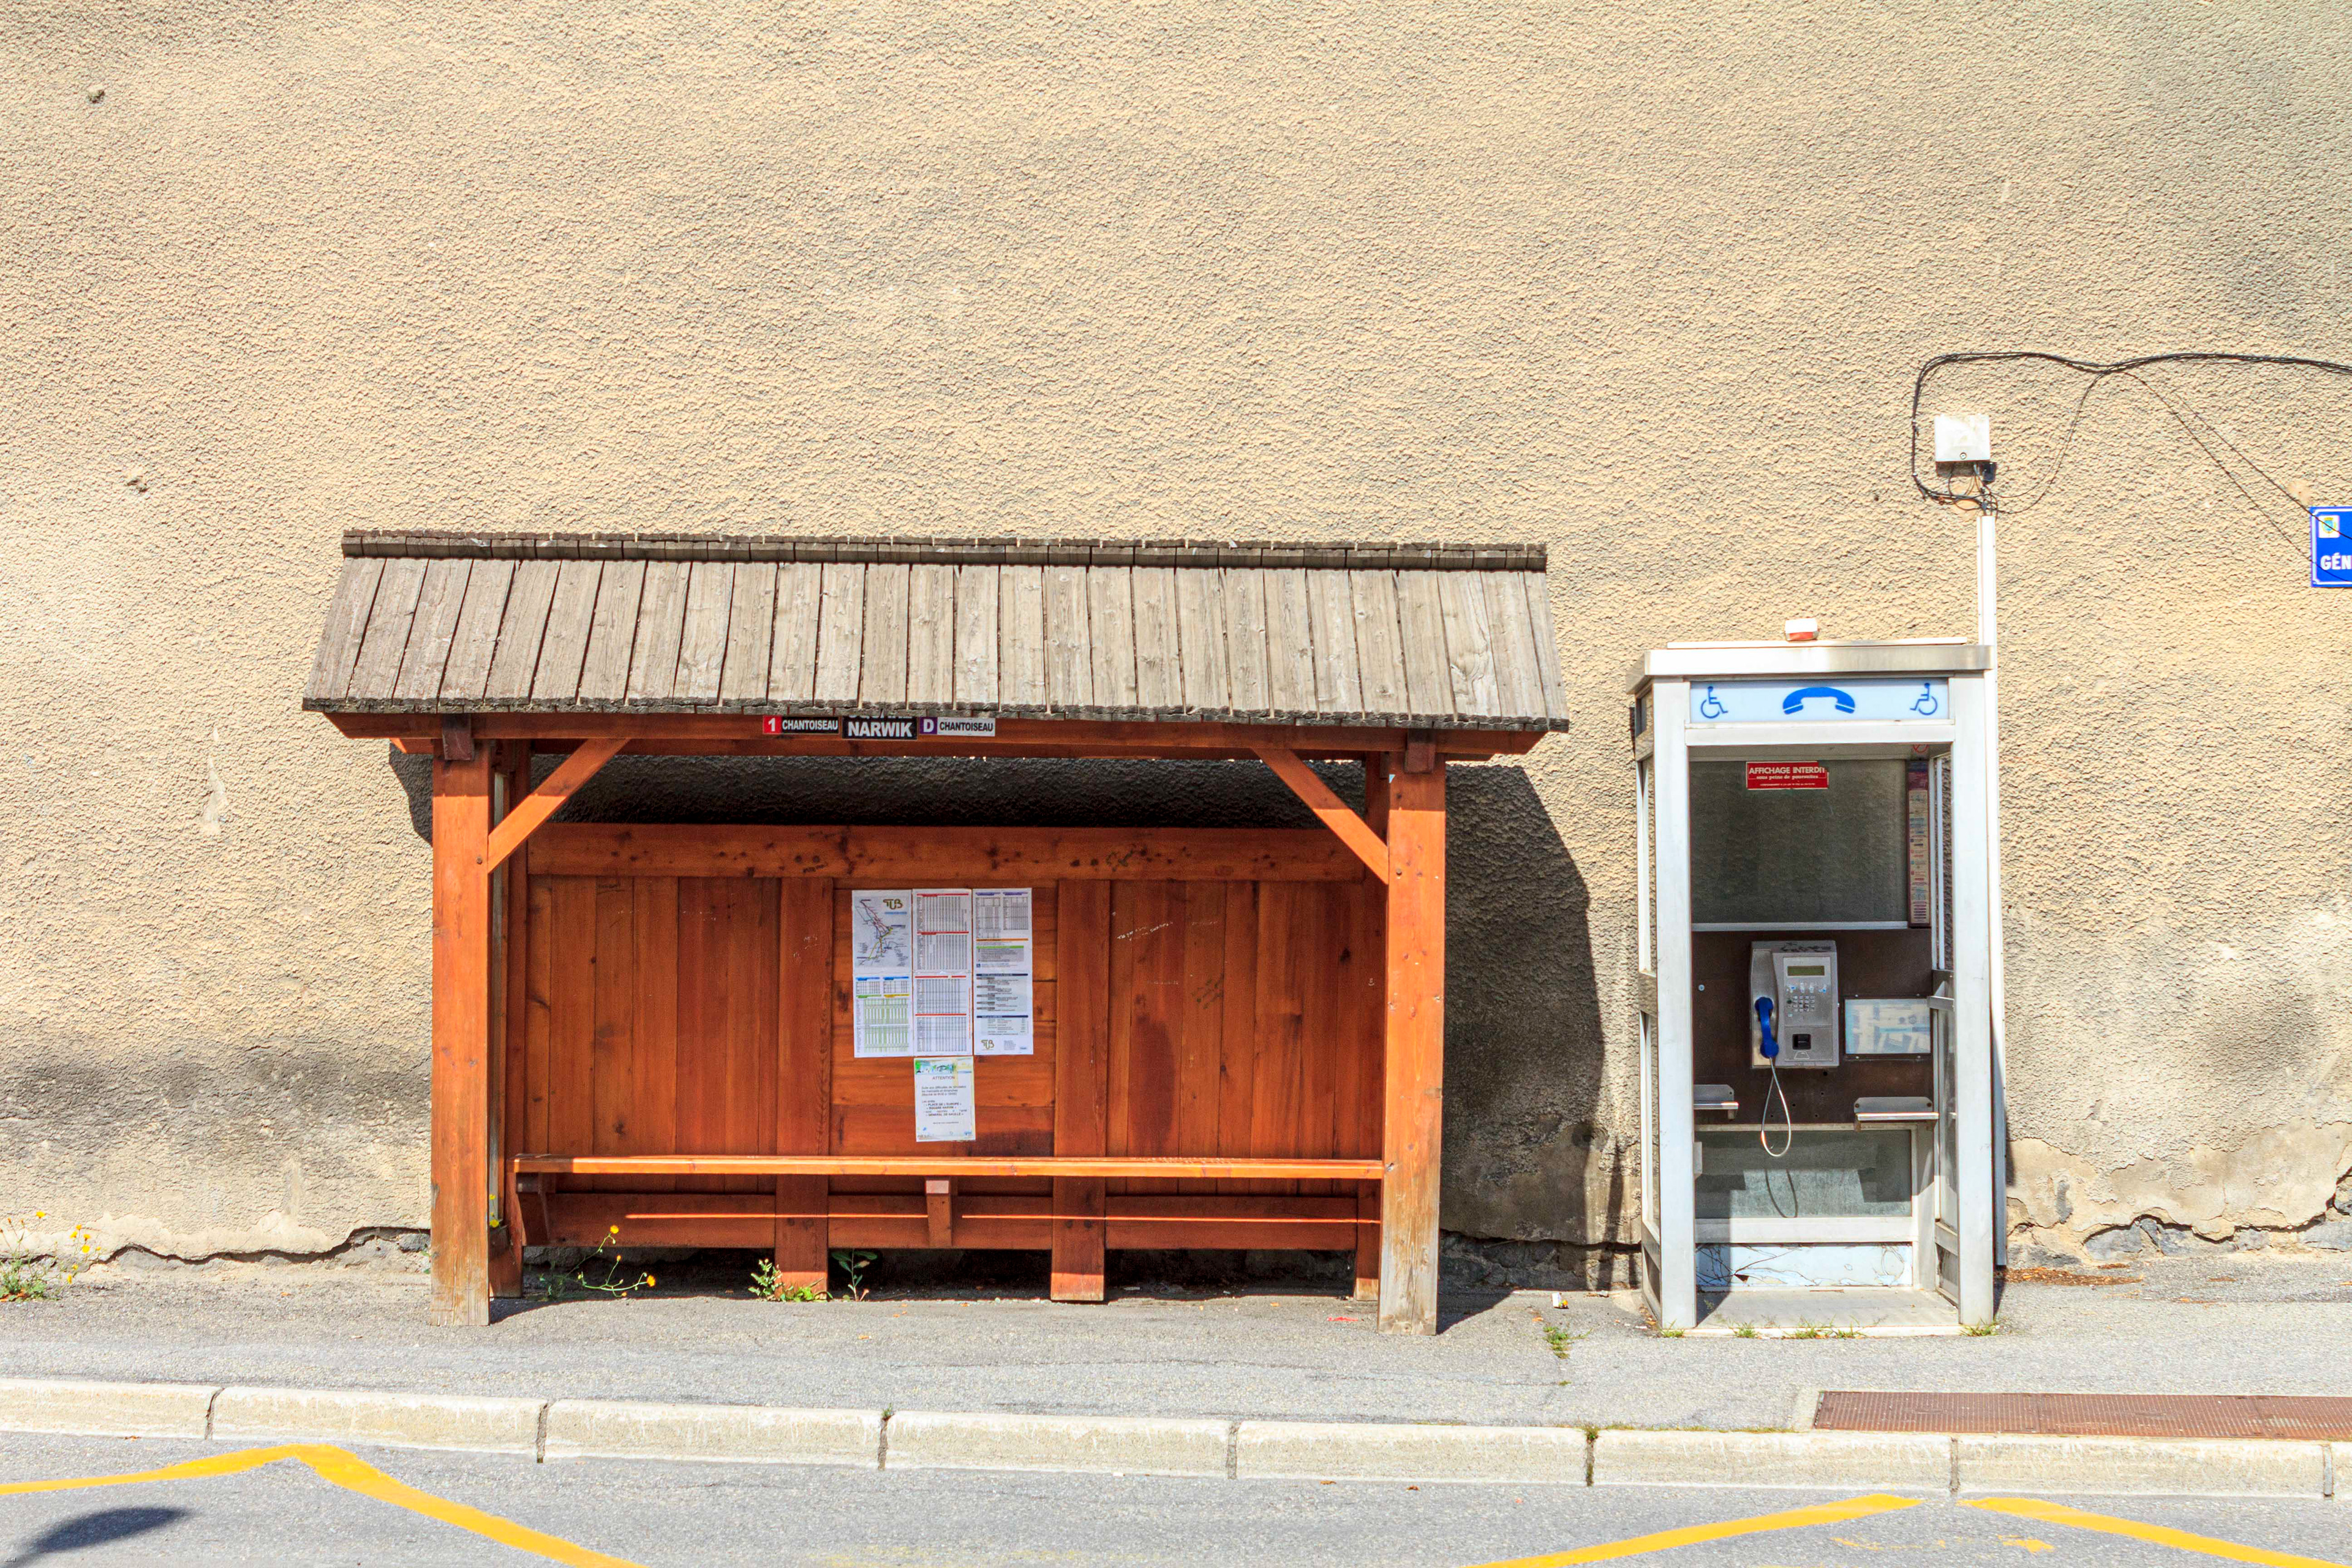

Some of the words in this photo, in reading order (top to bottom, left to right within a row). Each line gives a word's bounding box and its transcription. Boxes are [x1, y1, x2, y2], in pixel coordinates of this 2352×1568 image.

[2320, 552, 2351, 570] GÉN
[768, 718, 775, 732] 1
[782, 720, 839, 730] CHANTOISEAU
[848, 722, 913, 737] NARWIK
[923, 718, 934, 733] D
[939, 722, 993, 731] CHANTOISEAU
